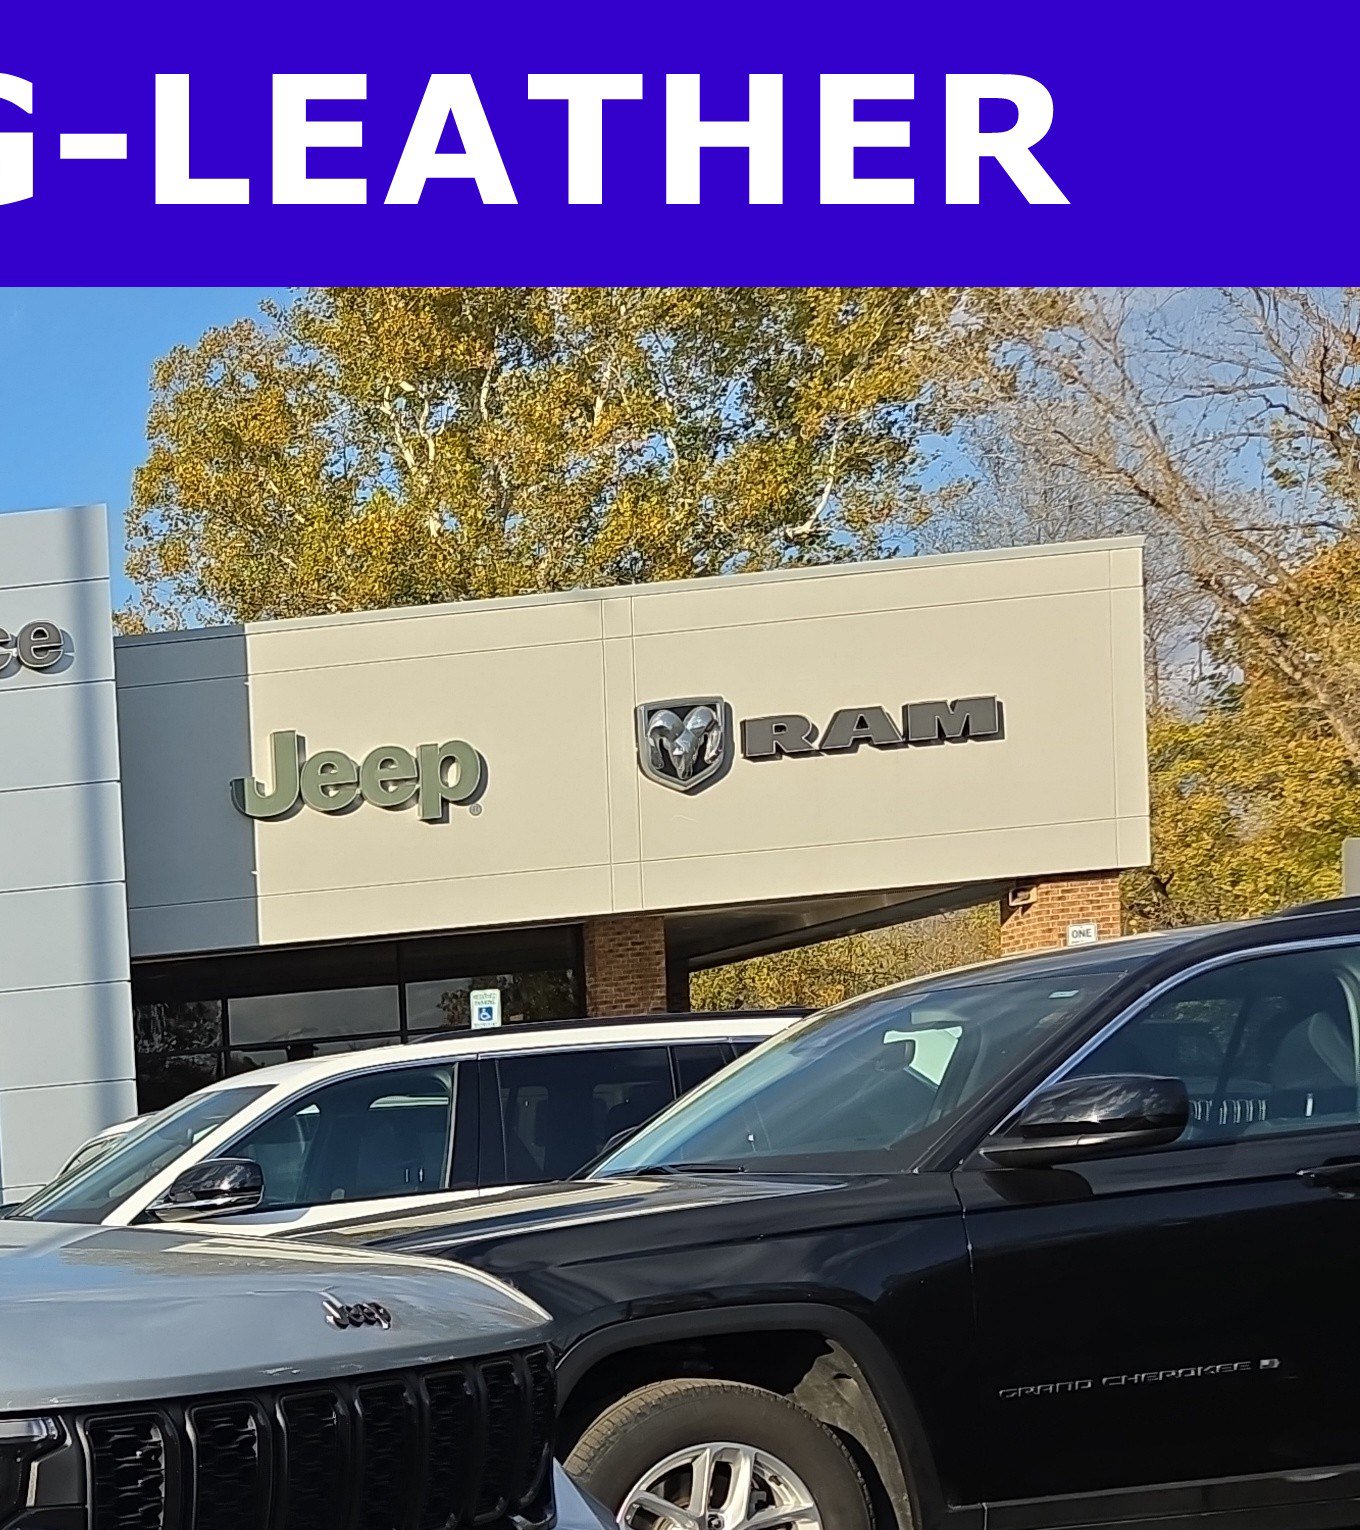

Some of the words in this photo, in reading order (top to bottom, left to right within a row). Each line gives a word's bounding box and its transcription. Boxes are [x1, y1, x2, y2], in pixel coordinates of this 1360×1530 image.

[743, 696, 1001, 761] RAM
[232, 729, 484, 823] Jeep
[322, 1300, 392, 1330] Jeep
[998, 1379, 1094, 1400] GRAND
[1101, 1360, 1252, 1386] CHEROKEE
